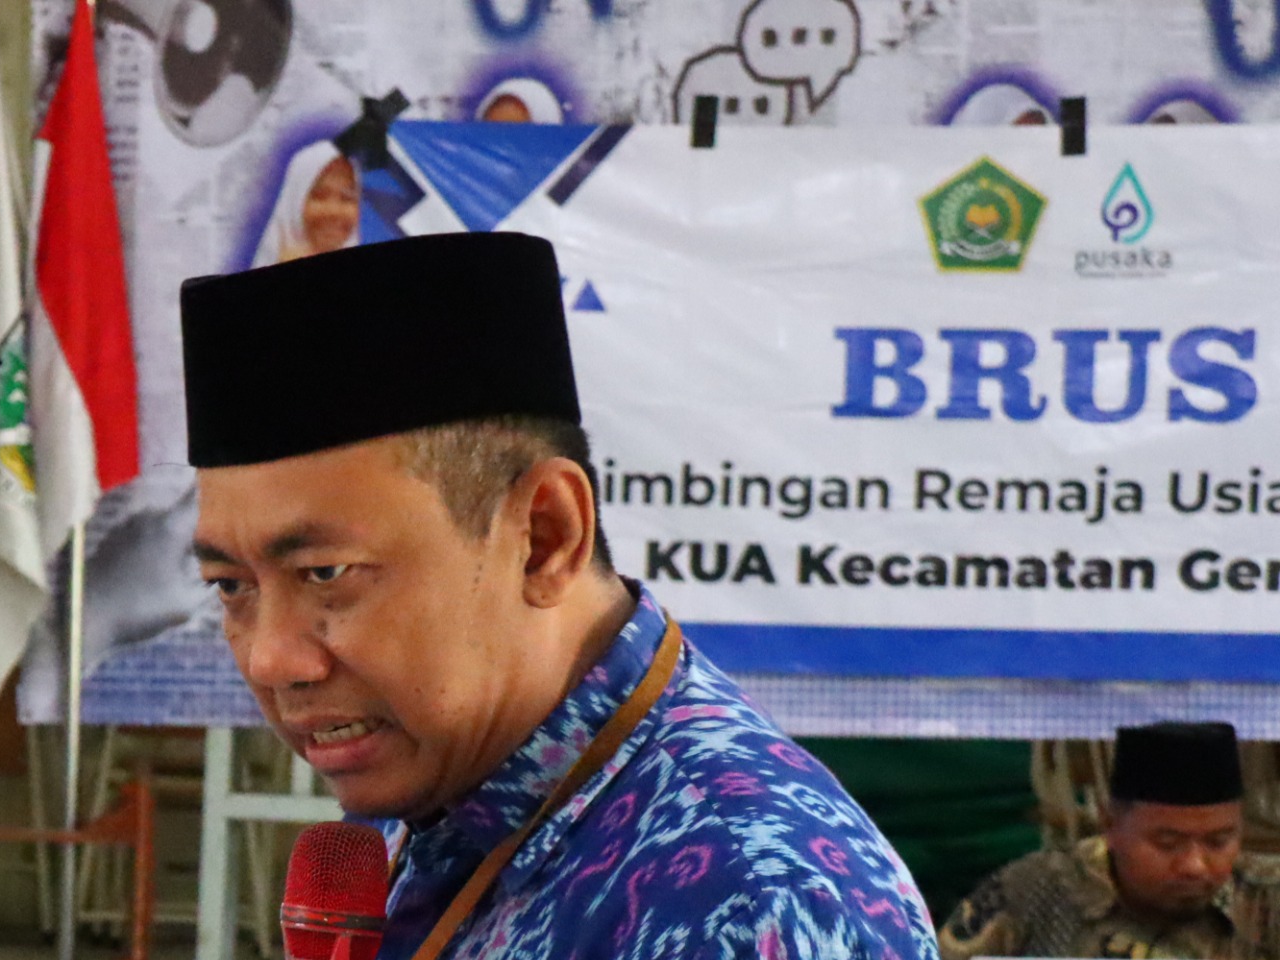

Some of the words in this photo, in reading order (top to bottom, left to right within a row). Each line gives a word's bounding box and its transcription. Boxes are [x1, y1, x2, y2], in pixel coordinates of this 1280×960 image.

[1074, 249, 1173, 272] pusaka
[830, 326, 1259, 424] BRUS
[603, 458, 891, 520] imbingan
[914, 465, 1145, 525] Remaja
[646, 541, 776, 582] KUA
[797, 544, 1156, 591] Kecamatan
